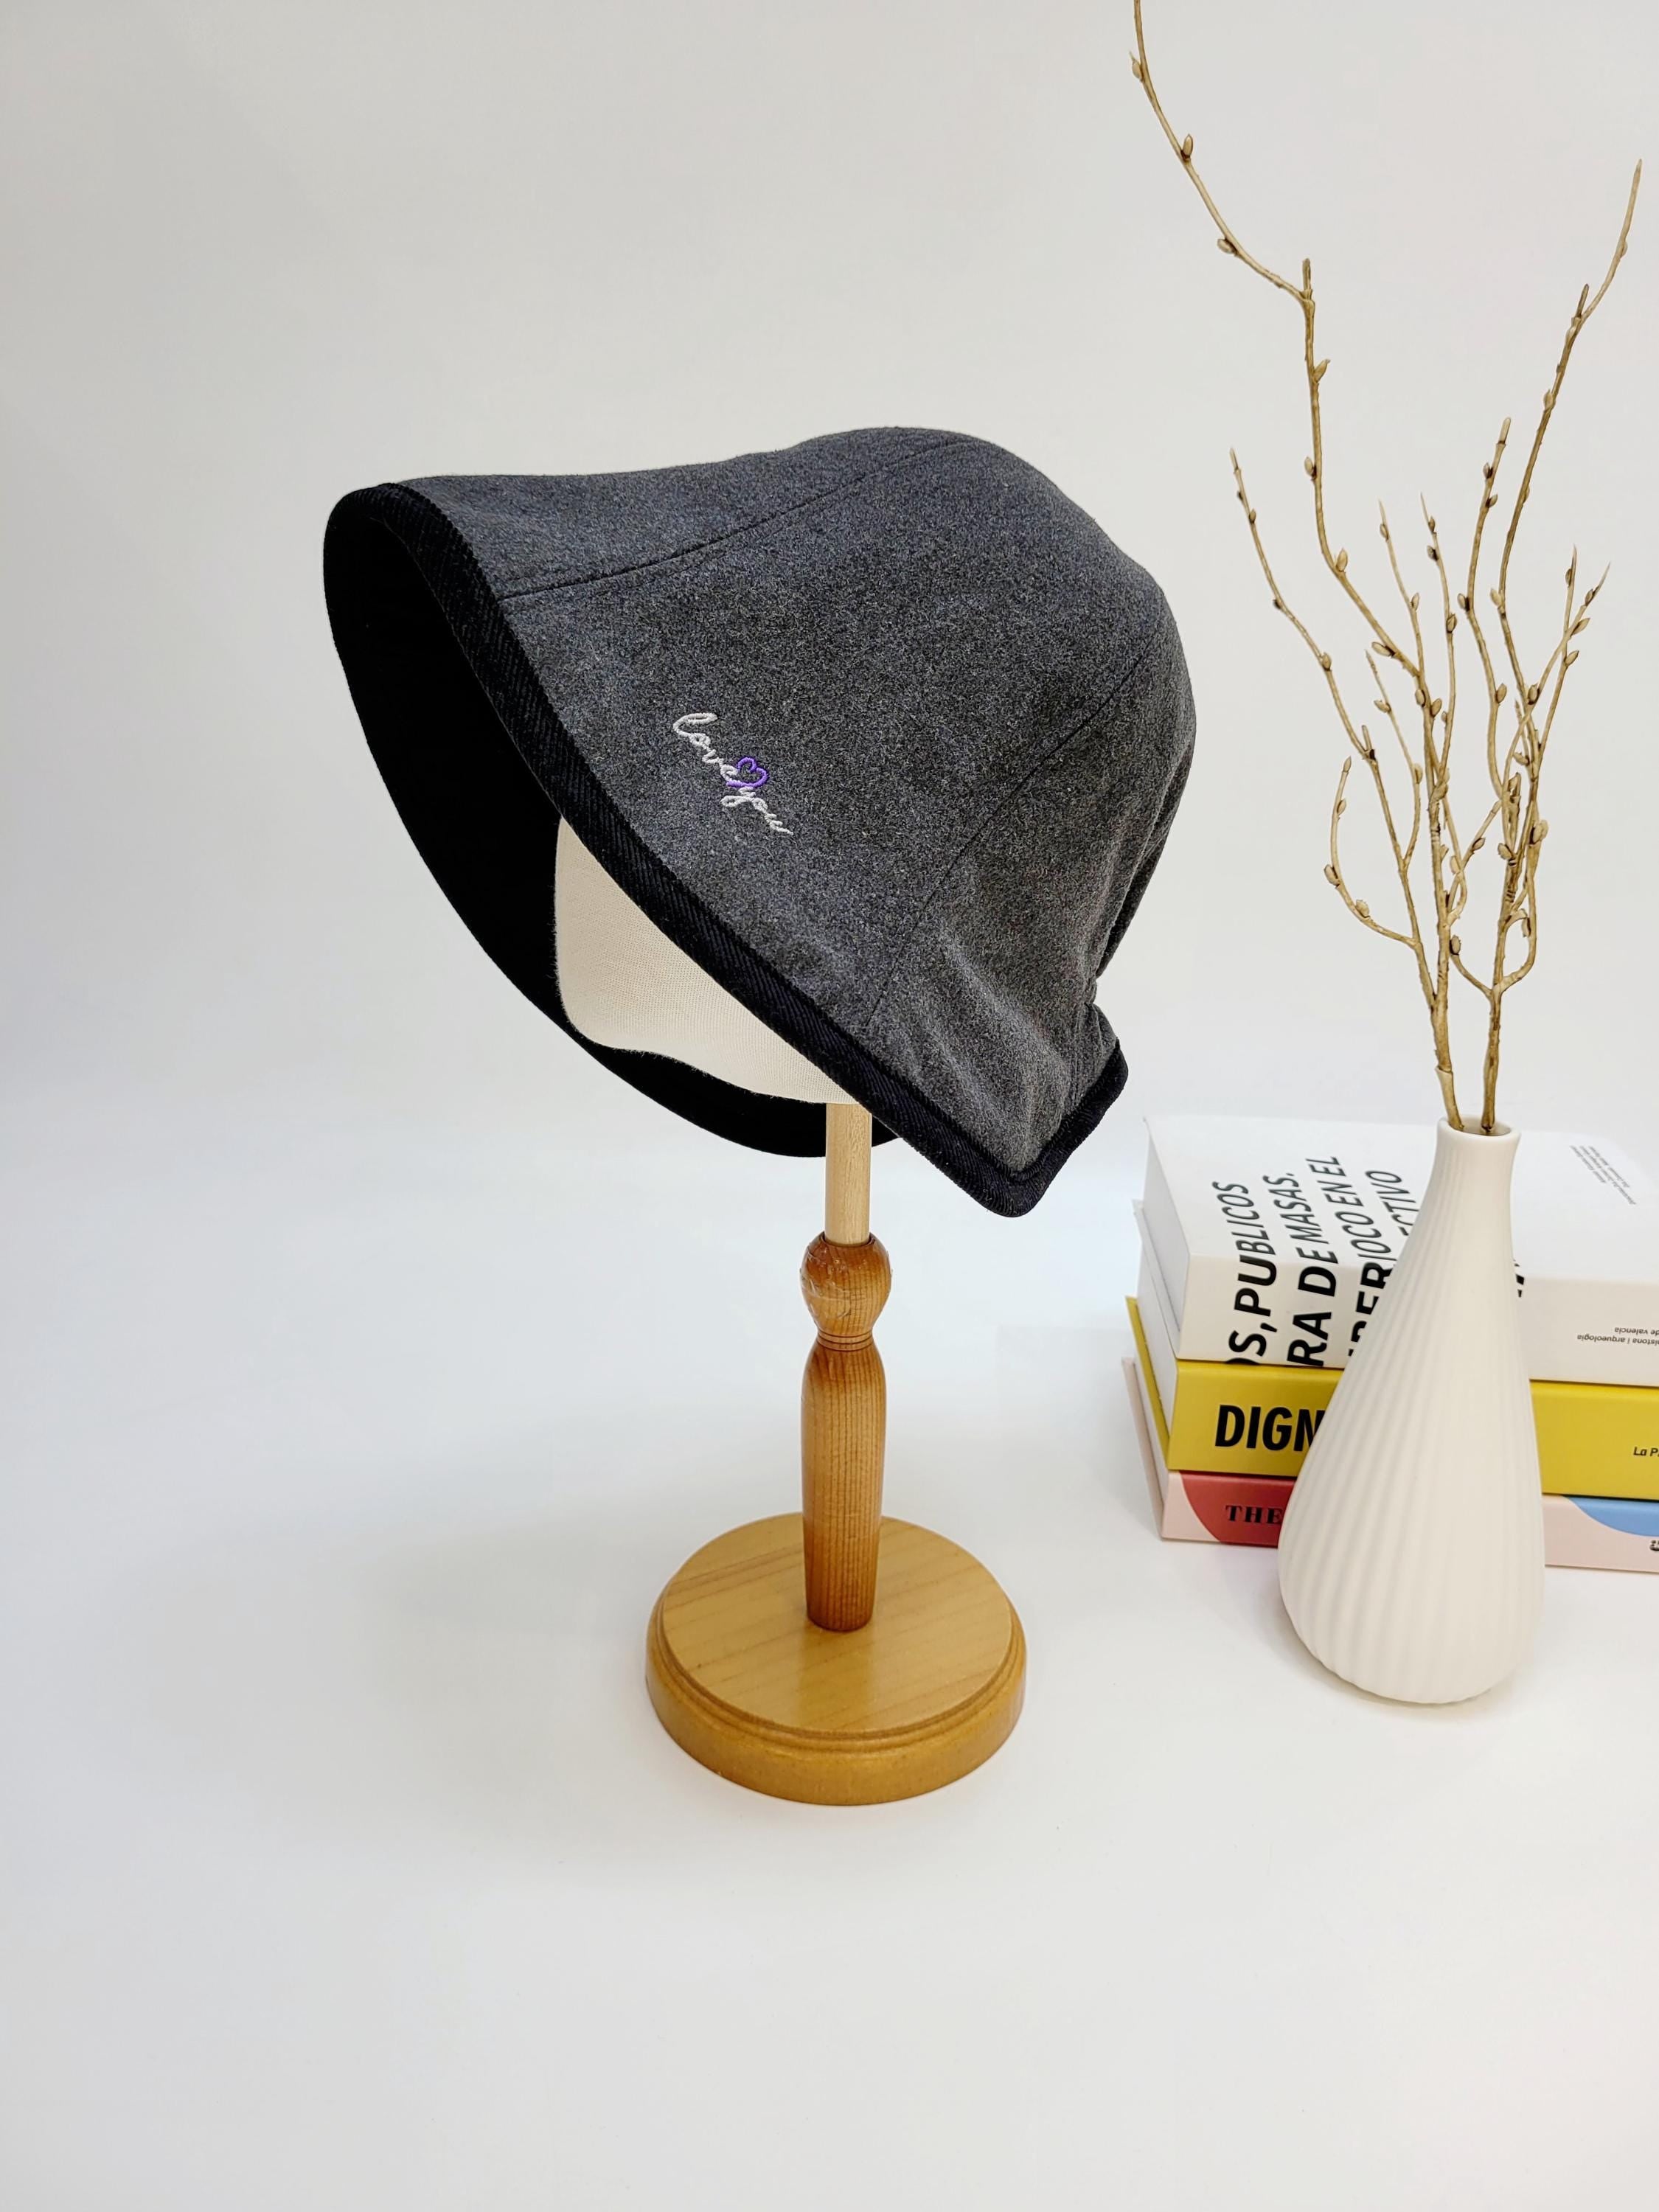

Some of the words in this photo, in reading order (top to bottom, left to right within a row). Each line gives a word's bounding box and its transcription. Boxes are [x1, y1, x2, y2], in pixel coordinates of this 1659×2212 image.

[720, 785, 794, 835] you
[1306, 1156, 1347, 1177] EL
[1316, 1180, 1364, 1207] EN
[1262, 1172, 1329, 1245] MASAS.
[1211, 1180, 1277, 1317] PUBLICOS
[1295, 1247, 1338, 1297] DE
[1614, 1327, 1649, 1335] valencia
[1633, 1446, 1648, 1457] La
[1225, 1504, 1284, 1525] THE
